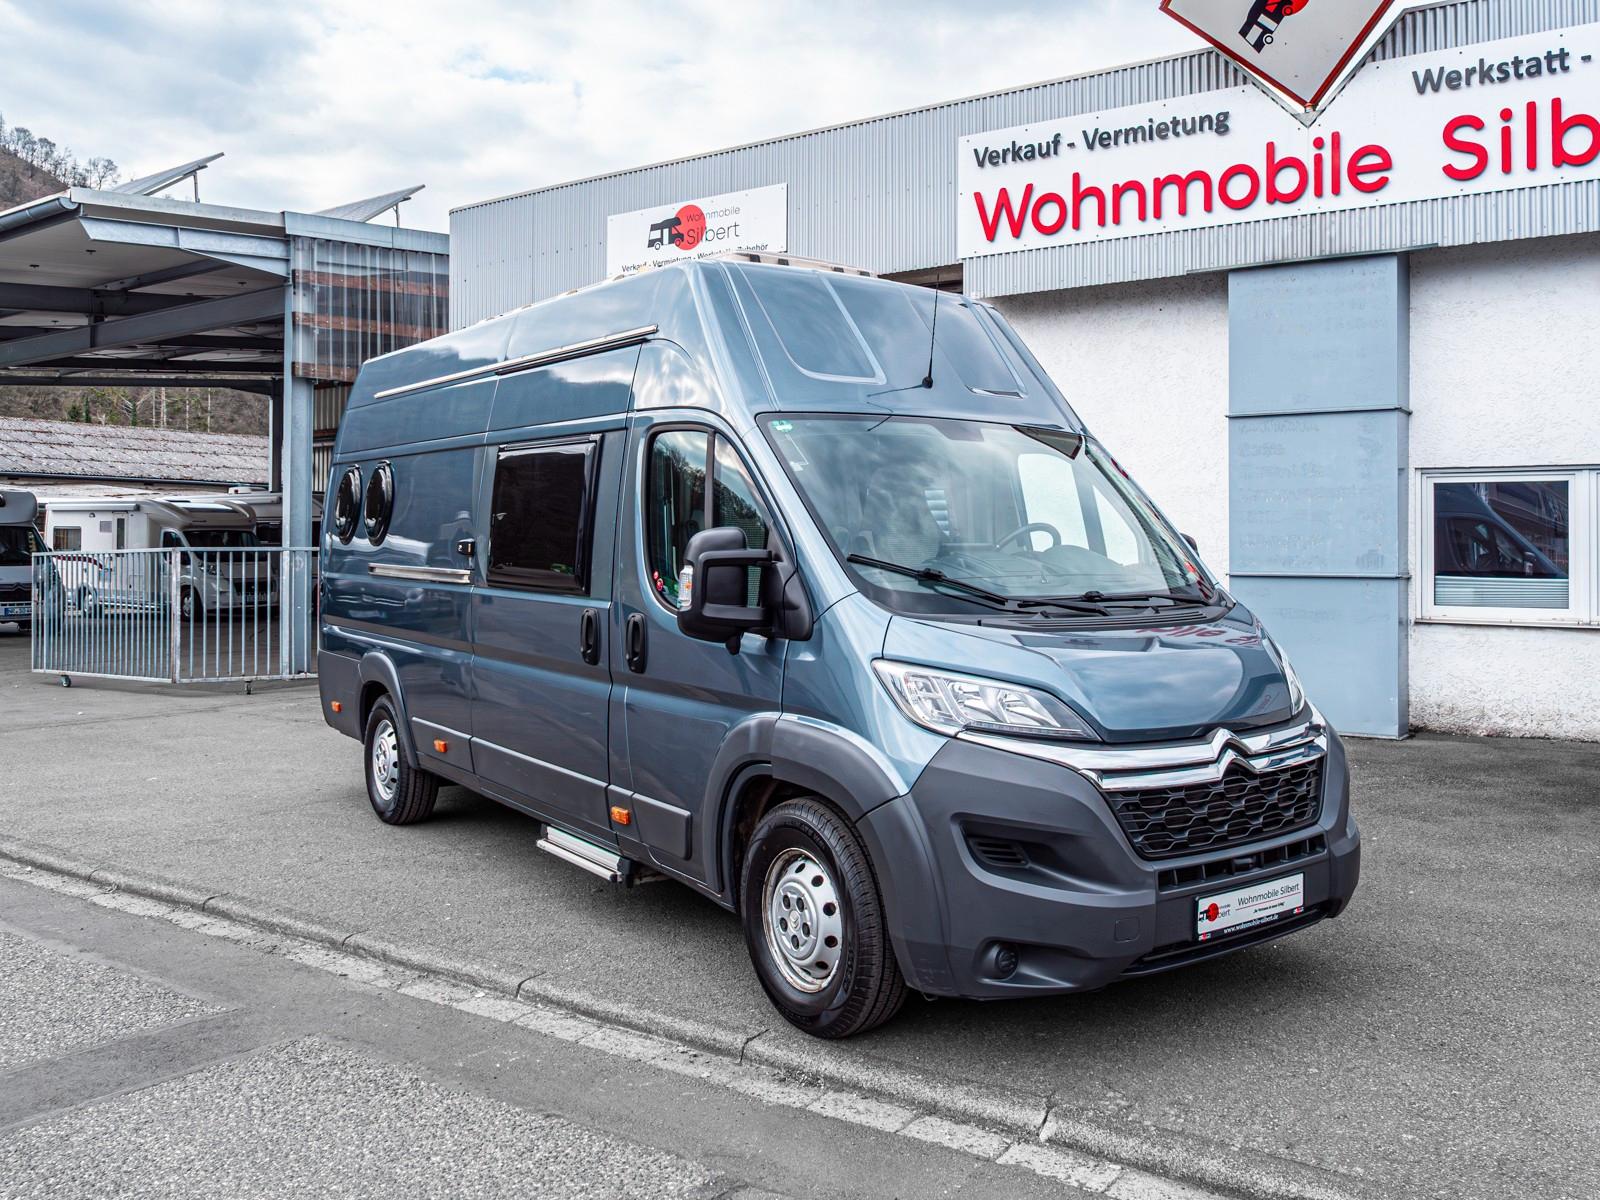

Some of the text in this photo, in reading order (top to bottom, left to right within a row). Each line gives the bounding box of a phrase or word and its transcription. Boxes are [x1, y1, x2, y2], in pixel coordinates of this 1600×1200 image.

[1411, 48, 1570, 96] Werkstatt
[973, 132, 1062, 169] Verkauf
[1081, 111, 1230, 151] Vermietung
[973, 97, 1600, 241] Wohnmobile Silb
[686, 205, 741, 225] Wohnmobile
[686, 221, 741, 246] Silbert
[1237, 889, 1279, 907] Wohnmobile
[1280, 883, 1300, 896] Silbert
